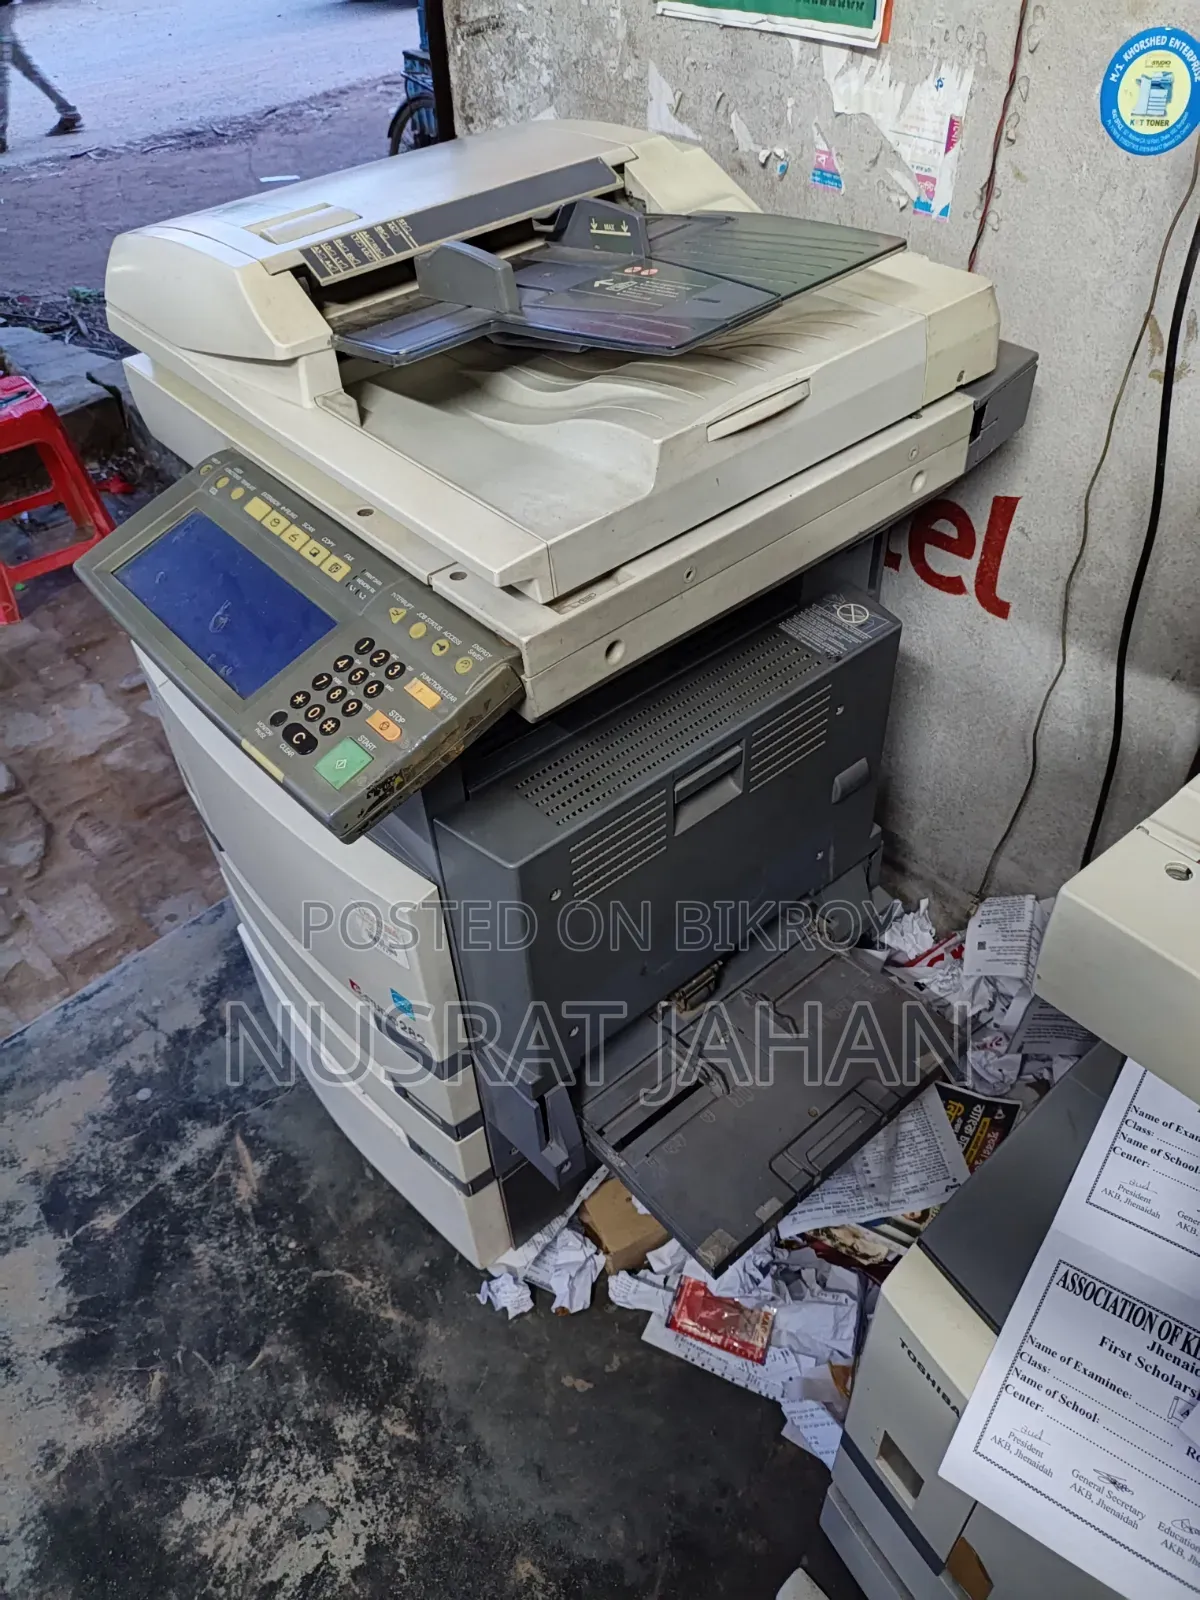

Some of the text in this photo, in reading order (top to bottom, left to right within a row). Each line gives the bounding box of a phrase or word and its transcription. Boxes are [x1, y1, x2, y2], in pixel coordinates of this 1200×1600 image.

[1109, 63, 1125, 83] M/S.
[1123, 36, 1167, 62] KHORSHED
[1146, 119, 1170, 127] TONER
[604, 223, 616, 231] MAX
[301, 522, 316, 533] SCAN
[321, 536, 336, 548] COPY
[343, 553, 355, 563] FAX
[884, 496, 1023, 620] el
[356, 577, 371, 590] MEMORY
[390, 592, 415, 610] INTERRUPT
[416, 611, 444, 632] JOB STATUS
[359, 640, 370, 651] 1
[442, 631, 463, 647] ACCESS
[374, 653, 385, 663] 2
[467, 649, 485, 663] SAVER
[471, 643, 493, 659] ENERGY
[337, 659, 349, 669] 4
[388, 665, 400, 676] 3
[316, 676, 328, 686] 7
[352, 671, 364, 681] 5
[330, 689, 342, 699] 8
[367, 684, 379, 694] 6
[420, 672, 458, 704] FUNCTION CLEAR
[308, 707, 320, 718] 0
[346, 702, 358, 712] 9
[388, 709, 406, 724] STOP
[254, 728, 267, 740] PAUSE
[292, 732, 306, 745] C
[280, 743, 295, 757] CLEAR
[357, 735, 377, 751] START
[1131, 1104, 1160, 1124] Name
[1162, 1121, 1175, 1130] of
[1125, 1118, 1155, 1137] Class:
[1119, 1131, 1149, 1152] Name
[1150, 1147, 1164, 1158] of
[1113, 1145, 1151, 1169] Center:
[1117, 1183, 1152, 1205] President
[1101, 1187, 1161, 1220] AKB, Jhenaidah
[1055, 1269, 1160, 1335] ASSOCIATION
[1157, 1319, 1183, 1347] OF
[1098, 1335, 1133, 1362] First
[1020, 1351, 1052, 1374] Class:
[1026, 1334, 1133, 1401] Name of Examinee:
[899, 1336, 960, 1419] TOSHIBA
[1004, 1383, 1045, 1413] Center:
[1012, 1367, 1101, 1424] Name of School:
[1007, 1431, 1045, 1460] President
[990, 1434, 1013, 1456] AKB,
[1013, 1446, 1055, 1479] Jhenaidah
[1071, 1468, 1106, 1495] General
[1107, 1490, 1148, 1521] Secretary
[1069, 1482, 1095, 1505] AKB,
[1096, 1498, 1140, 1531] Jhenaidah
[1160, 1539, 1186, 1560] AKB,
